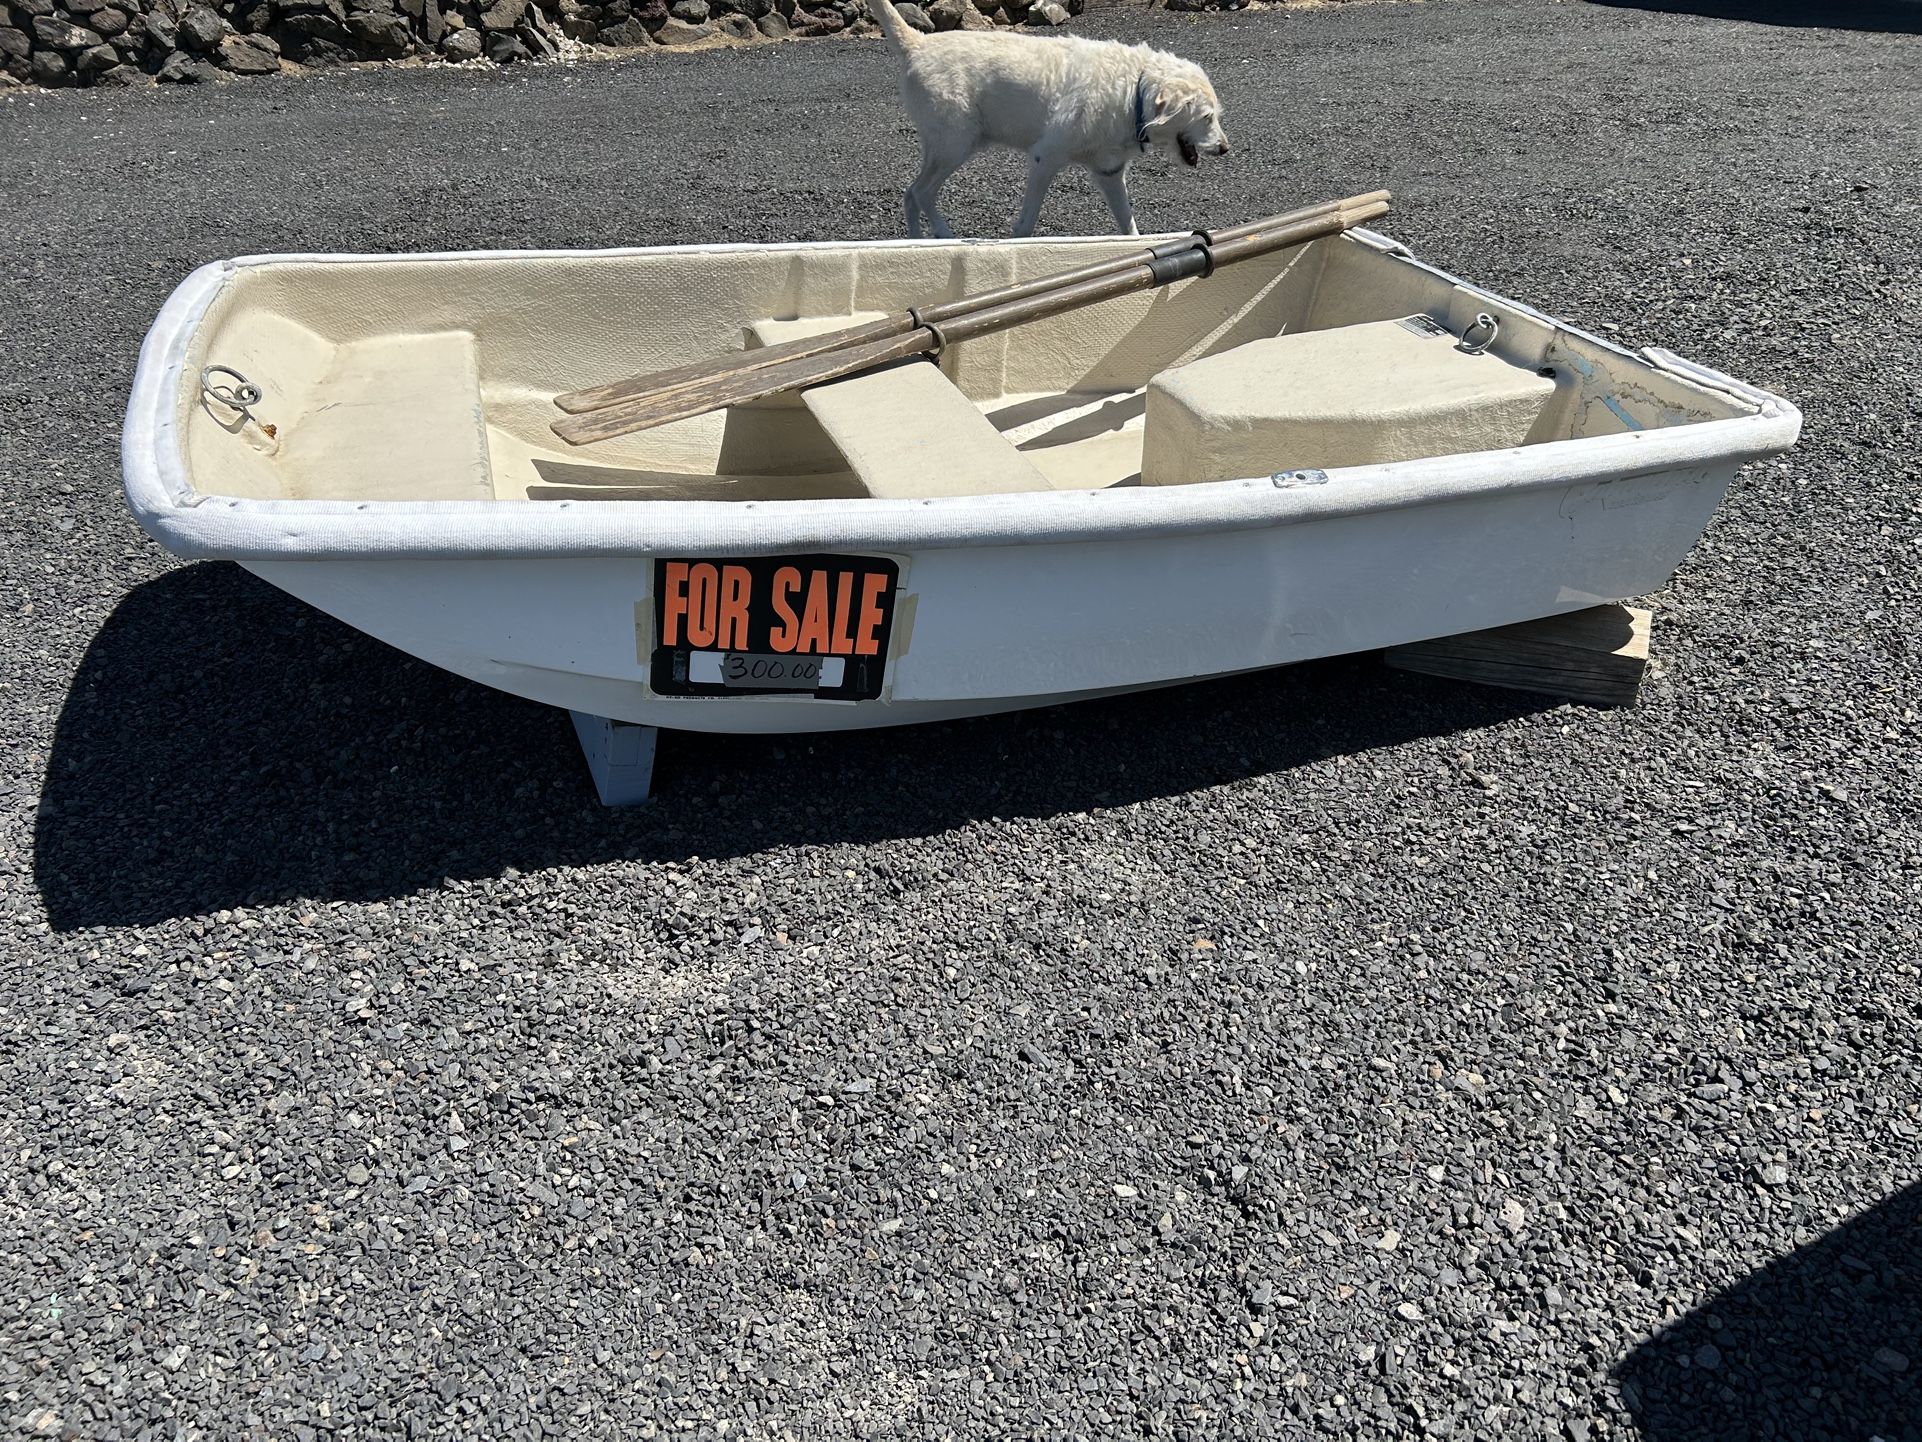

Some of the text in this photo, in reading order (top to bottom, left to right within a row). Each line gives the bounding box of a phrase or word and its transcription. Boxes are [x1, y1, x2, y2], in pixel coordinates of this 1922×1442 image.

[663, 562, 888, 655] FOR SALE
[728, 656, 817, 680] 300.00
